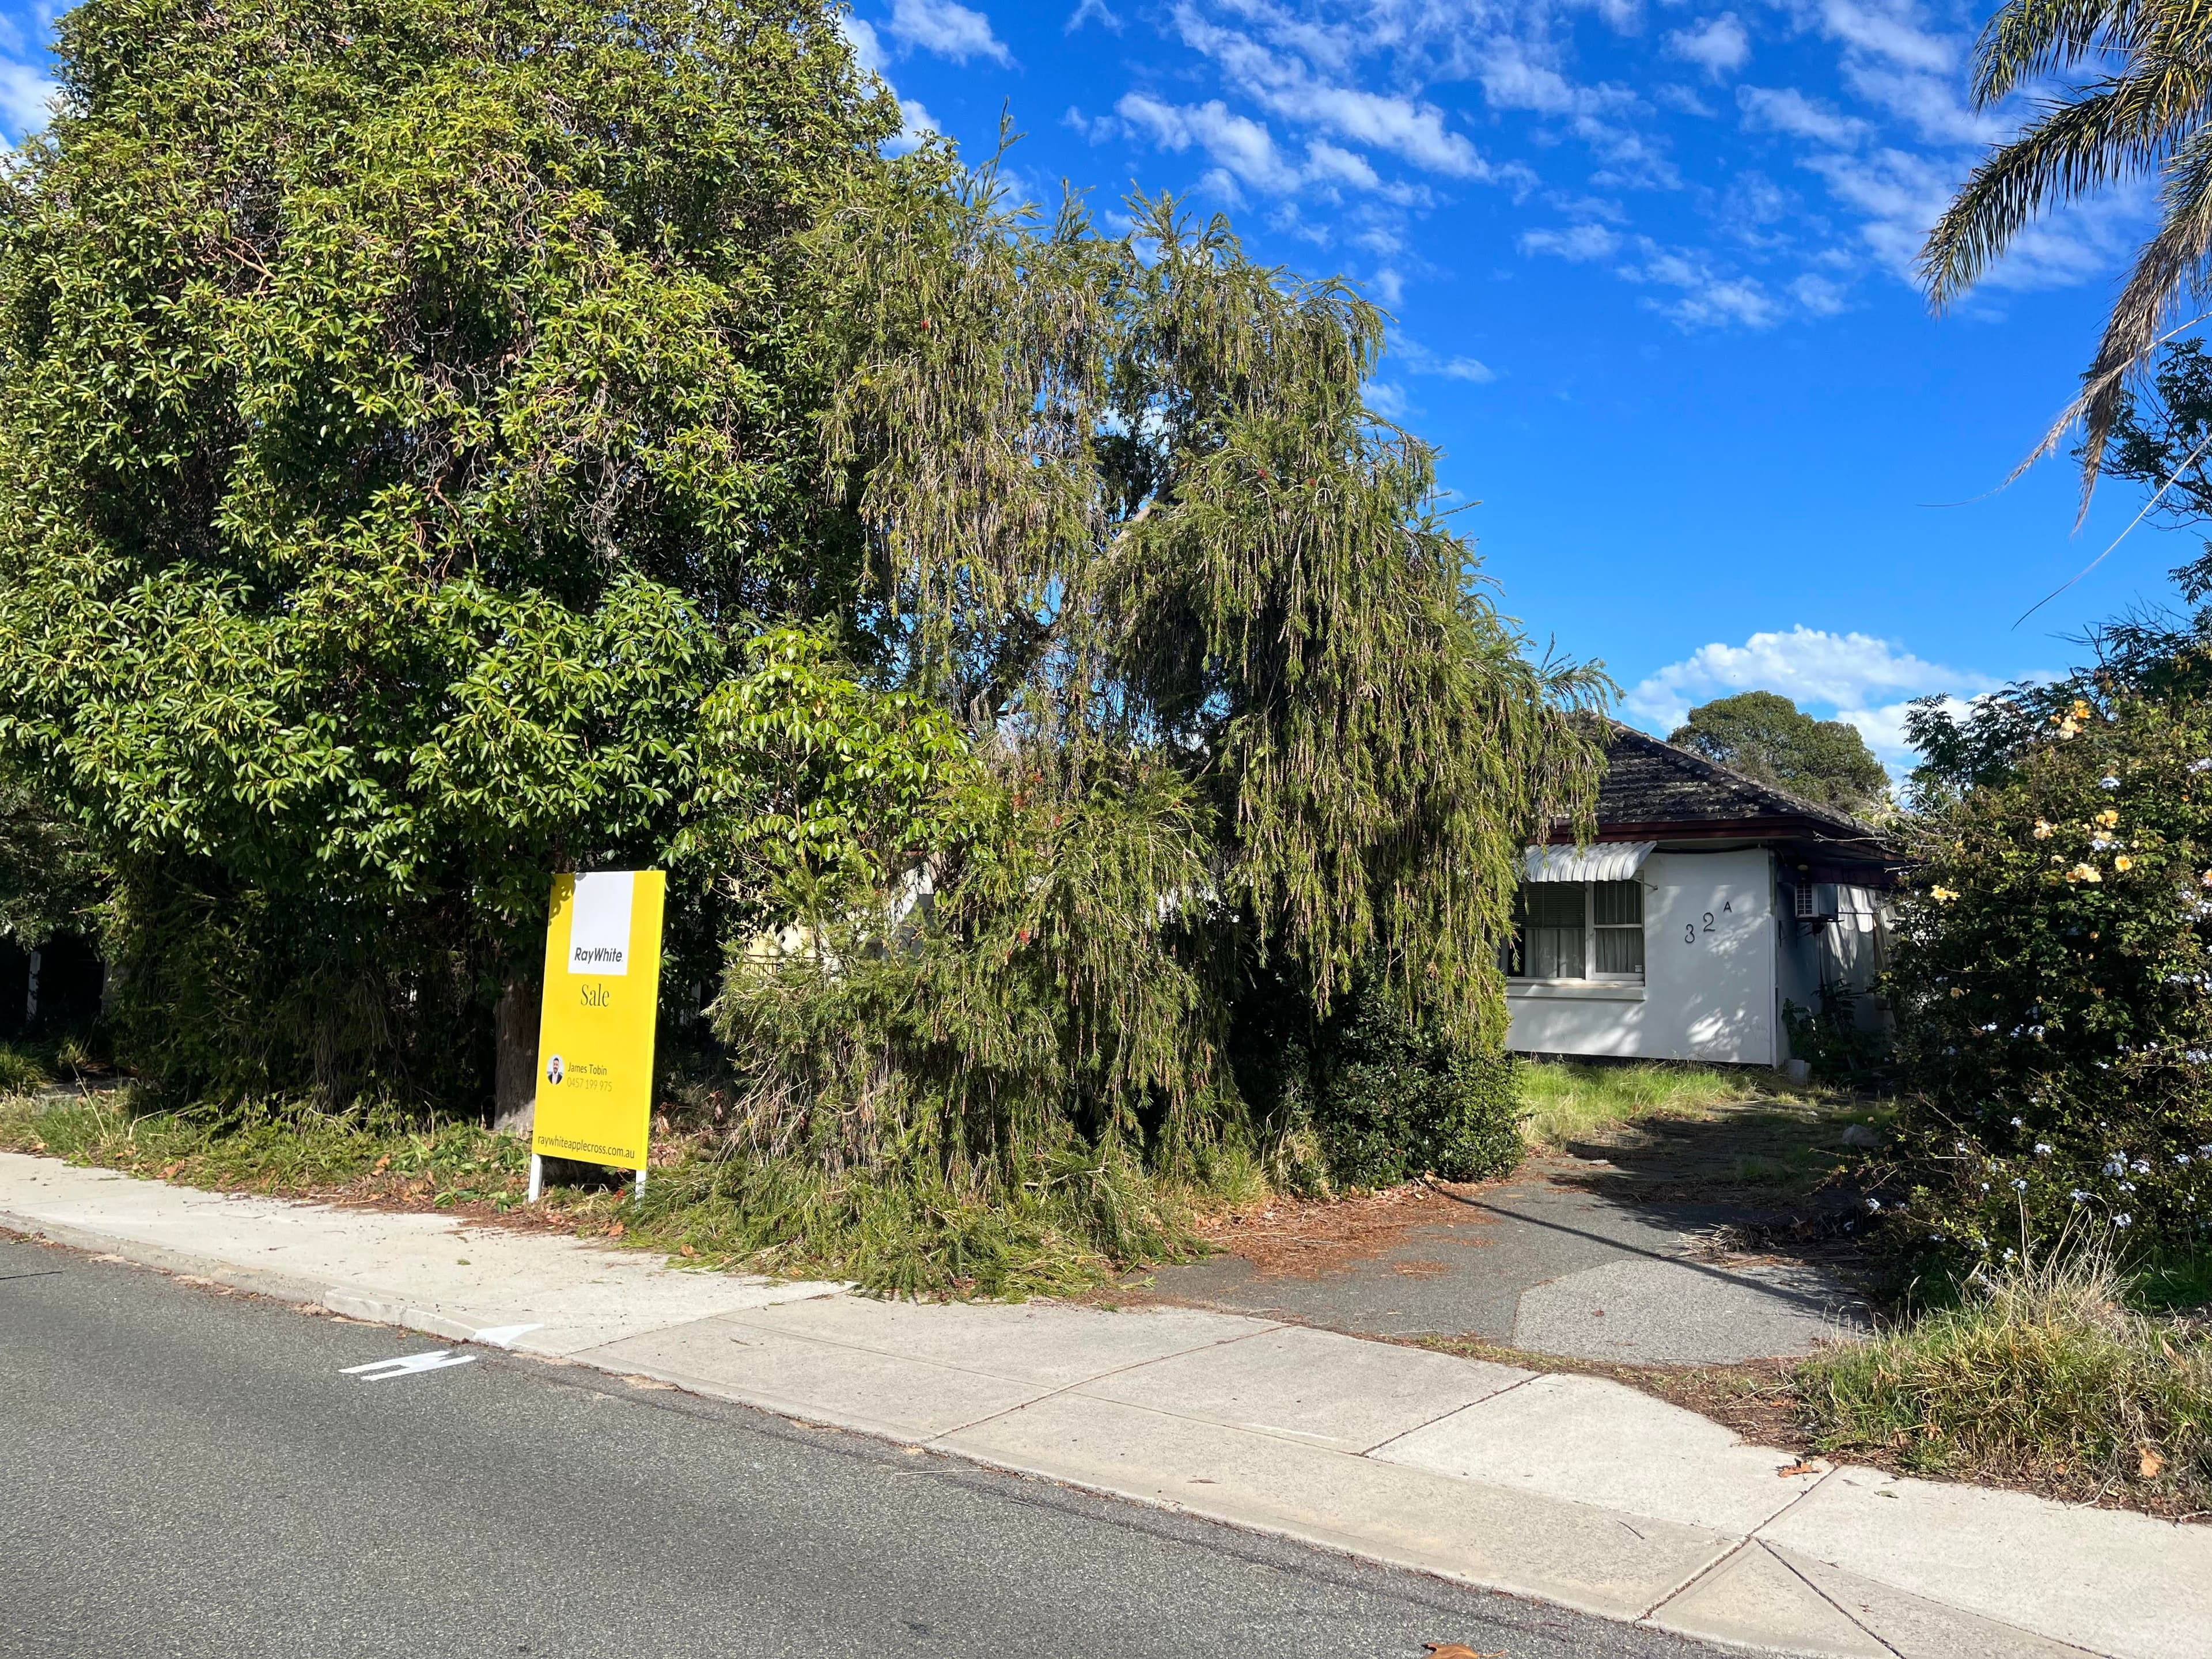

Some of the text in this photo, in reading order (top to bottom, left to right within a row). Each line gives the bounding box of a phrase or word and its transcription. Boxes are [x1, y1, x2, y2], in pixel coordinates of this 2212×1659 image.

[581, 983, 609, 1007] Sale
[567, 1062, 607, 1075] James Tobin
[567, 1077, 584, 1088] 0457
[600, 1080, 612, 1092] 975
[538, 1135, 635, 1159] raywhiteapplecross.com.au
